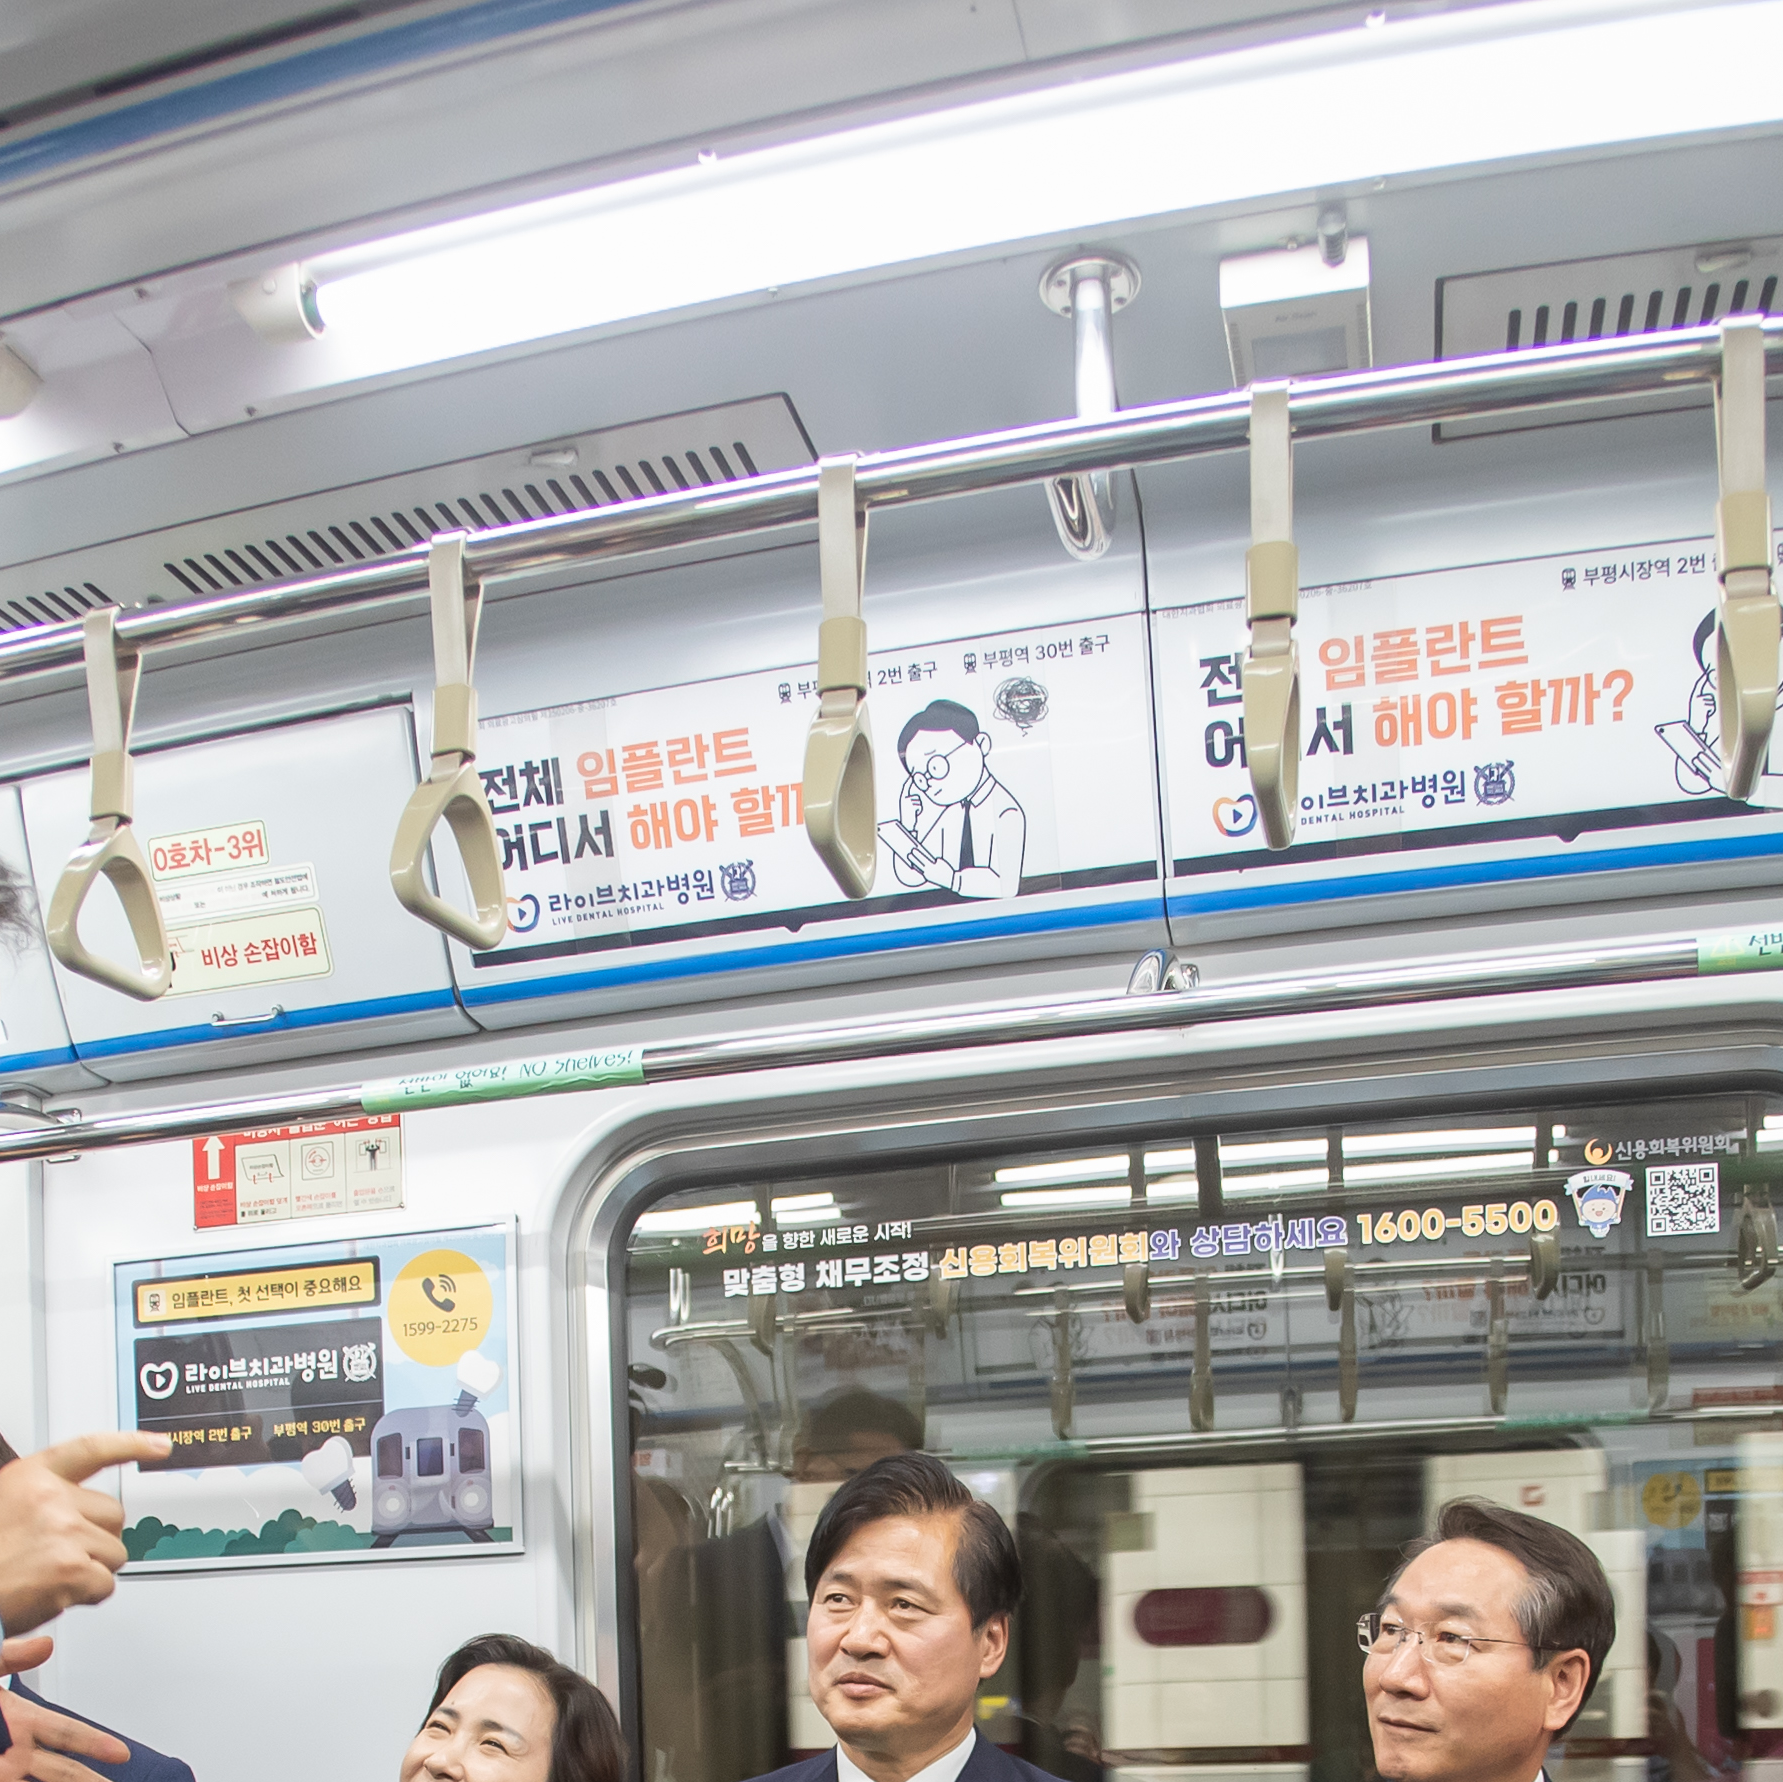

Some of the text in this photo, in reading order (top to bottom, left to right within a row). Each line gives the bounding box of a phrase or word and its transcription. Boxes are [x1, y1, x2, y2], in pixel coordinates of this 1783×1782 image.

[1582, 552, 1706, 586] 부평시장역 2번
[982, 634, 1111, 670] 부평역 30번 출구
[1199, 615, 1529, 708] 전 임플란트
[877, 661, 938, 686] 2번 출구
[1205, 669, 1634, 768] 어서 해야 할까?
[478, 727, 757, 815] 전체 임플란트
[1301, 769, 1467, 811] 이브치과병원
[1301, 804, 1405, 826] DENTAL HOSPITAL
[496, 810, 614, 872] 어디서
[627, 794, 719, 850] 해야
[548, 869, 716, 914] 라이브치과병원
[552, 902, 665, 926] LIVE DENTAL HOSPITAL
[201, 932, 318, 969] 비상 손잡이함
[519, 1062, 547, 1079] NO
[555, 1049, 634, 1074] Shelves!
[1615, 1135, 1732, 1161] 신용회복위원회
[702, 1221, 913, 1256] 희망을 향한 새로운 시작!
[723, 1198, 1559, 1299] 맞춤형 채무조정 신용회복위원회와 상담하세요 1600-5500
[172, 1275, 363, 1310] 임플란트, 첫 선택이 중요해요
[402, 1317, 478, 1337] 1599-2275
[185, 1348, 339, 1383] 라이브치과병원
[186, 1378, 290, 1394] LIVE DENTAL HOSPITAL
[208, 1428, 227, 1441] 2번
[230, 1426, 252, 1441] 출구
[273, 1417, 367, 1438] 부평역 30번 출구
